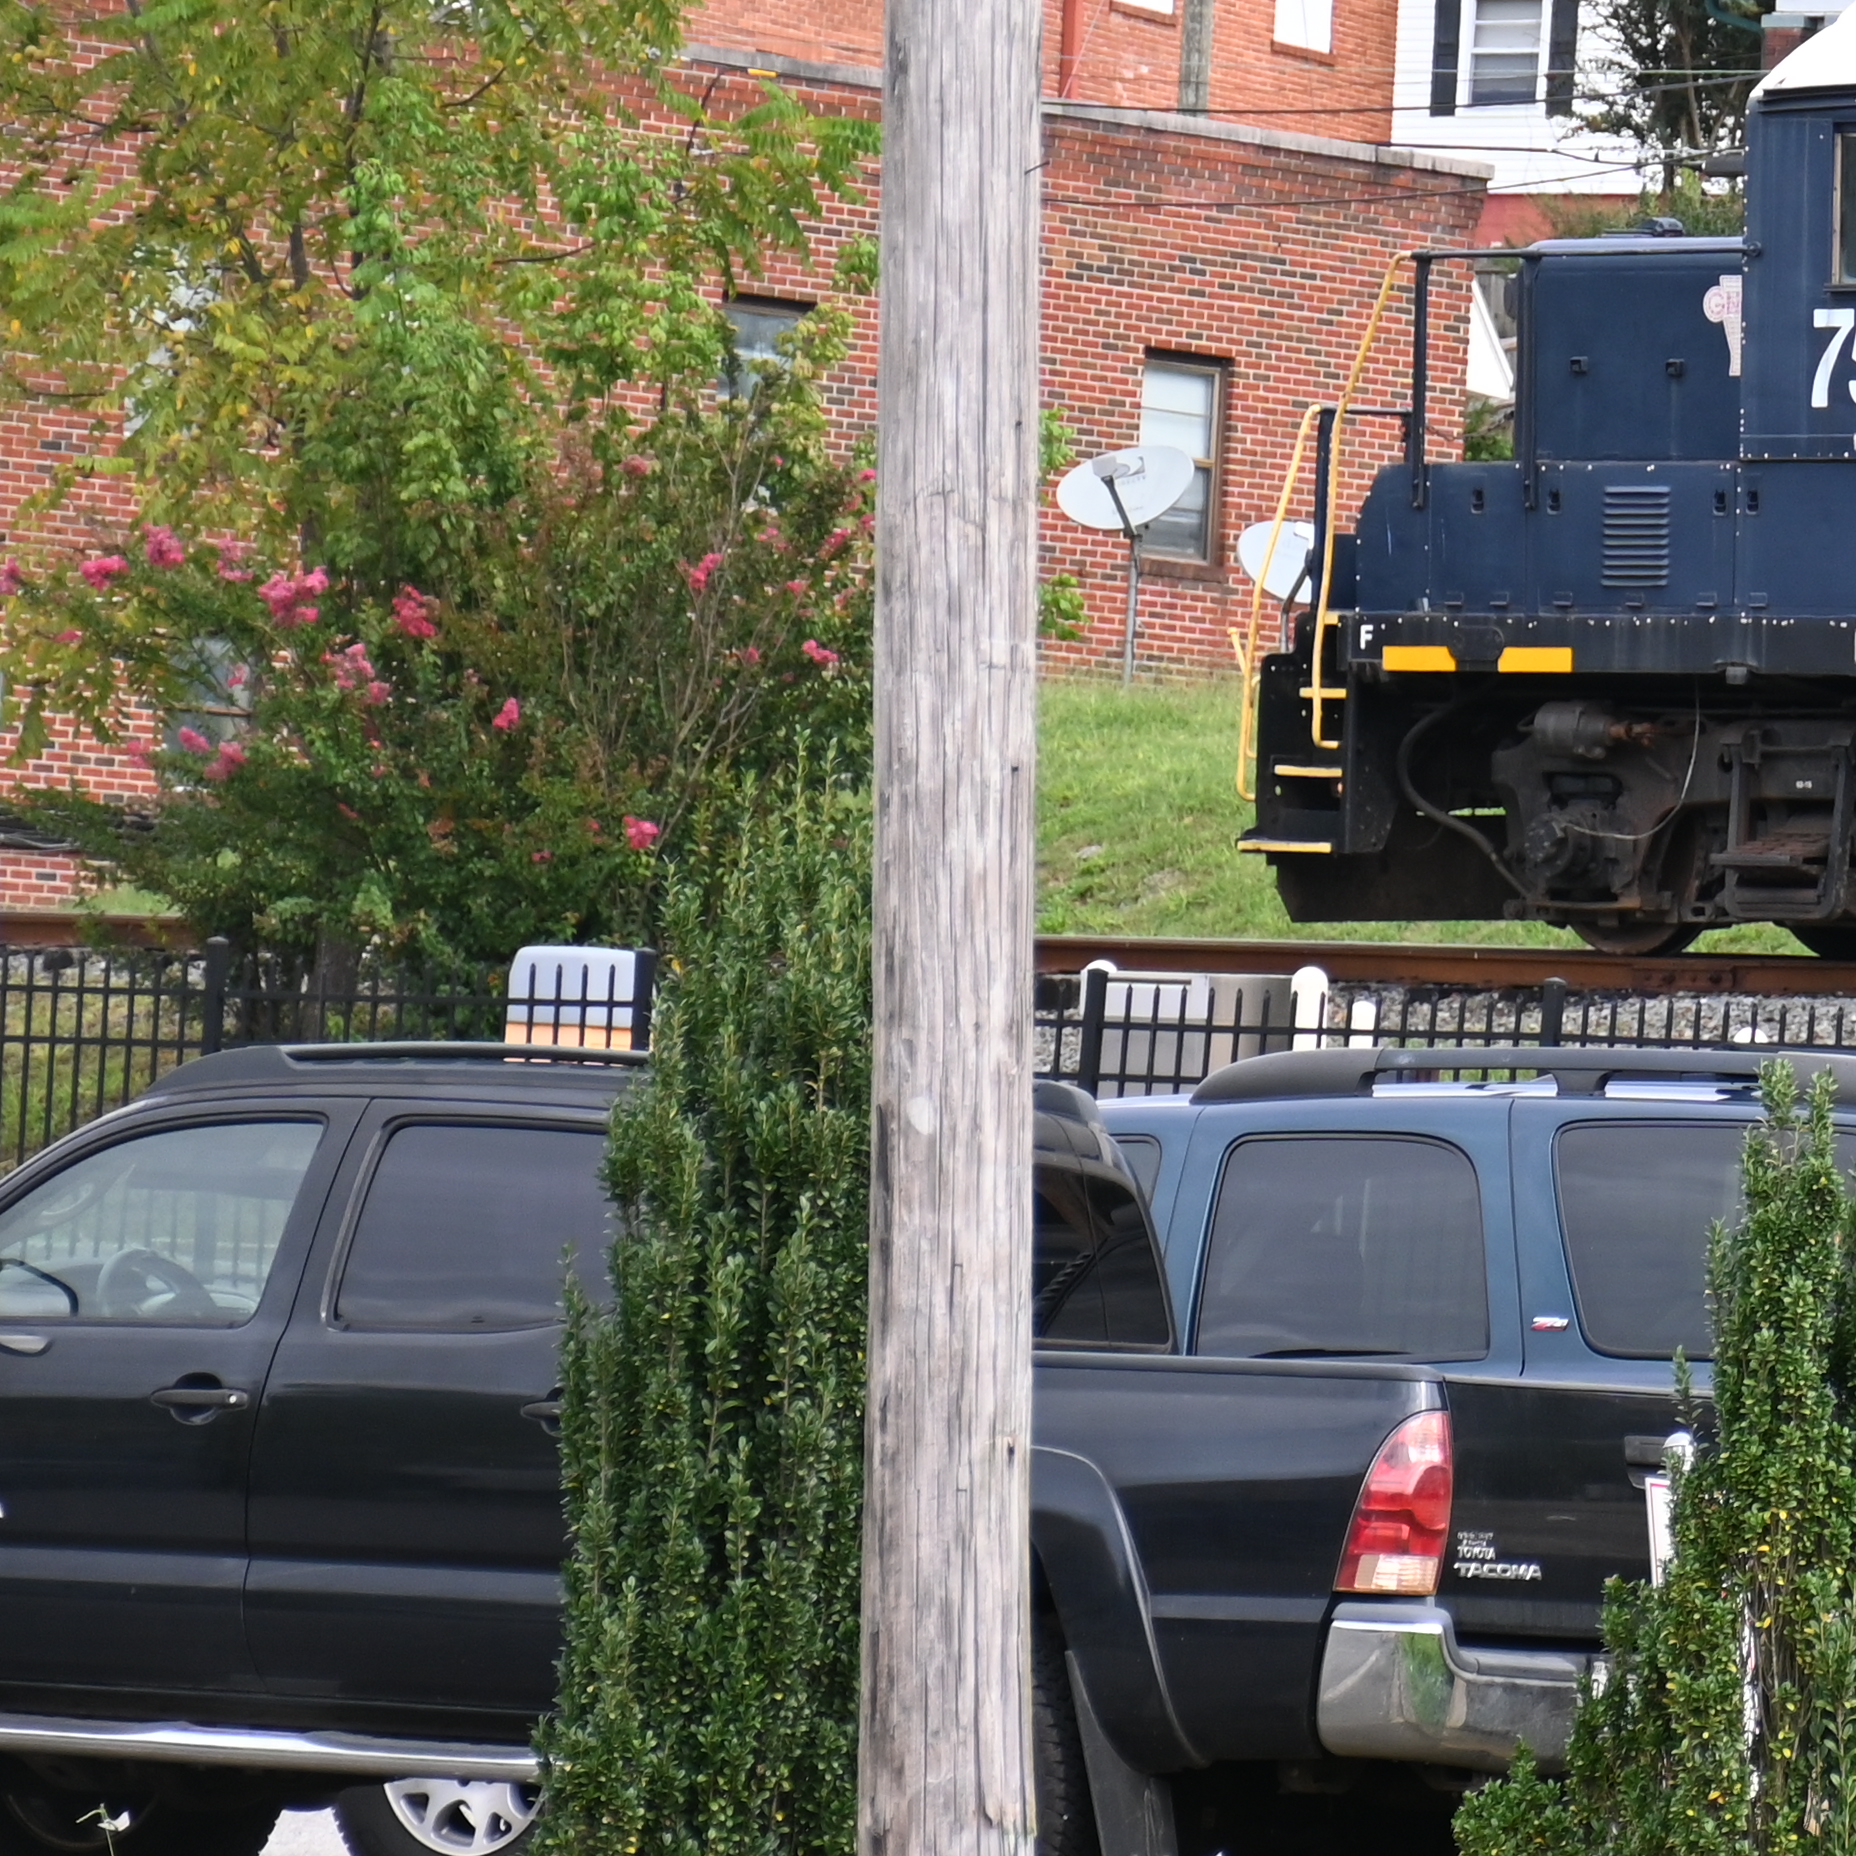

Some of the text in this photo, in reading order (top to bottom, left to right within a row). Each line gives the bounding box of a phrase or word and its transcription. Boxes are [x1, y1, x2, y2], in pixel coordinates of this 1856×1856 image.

[1360, 624, 1374, 650] F
[1457, 1546, 1496, 1560] TOYOTA
[1453, 1562, 1542, 1580] TACOMA
